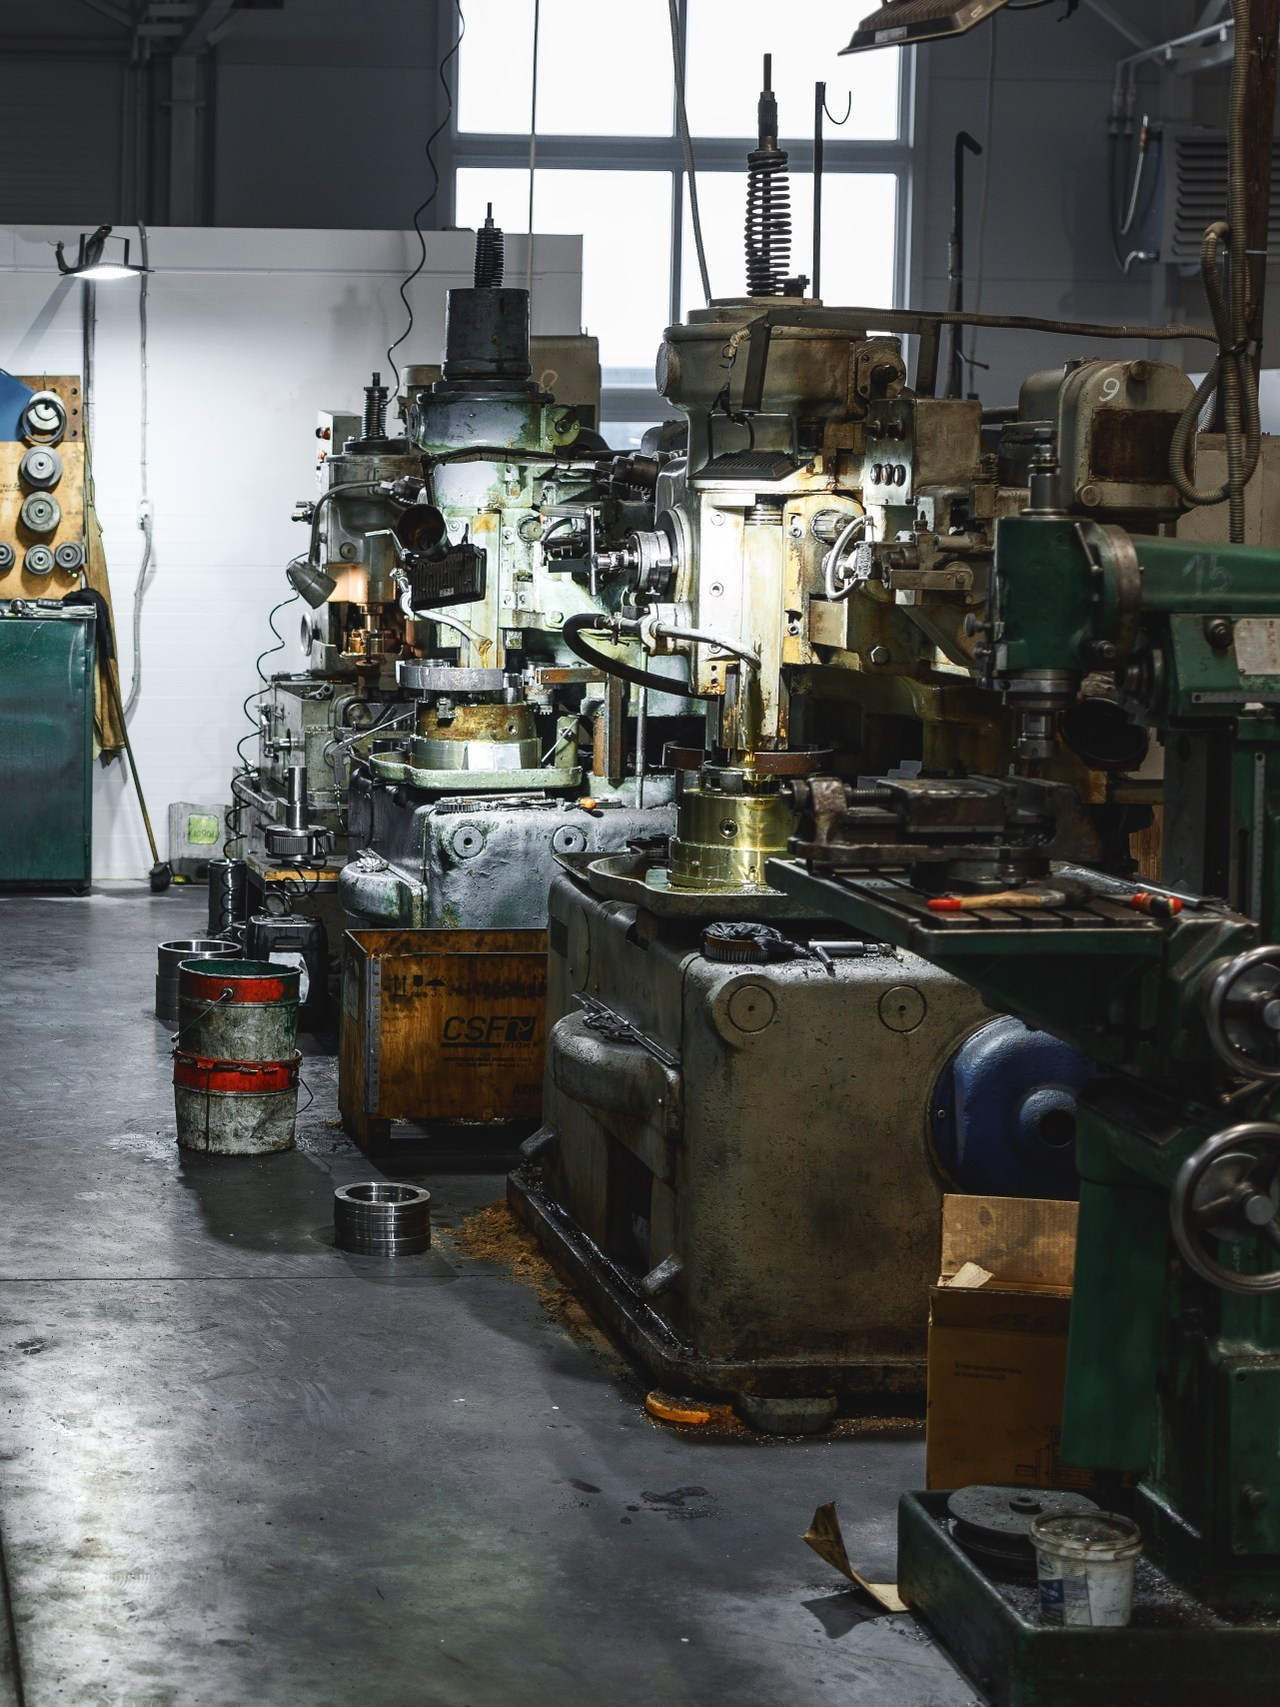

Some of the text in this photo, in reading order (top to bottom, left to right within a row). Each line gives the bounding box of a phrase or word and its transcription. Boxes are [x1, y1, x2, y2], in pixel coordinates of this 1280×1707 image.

[1098, 378, 1120, 402] 9
[1182, 553, 1232, 596] 15
[443, 1016, 507, 1041] CSF
